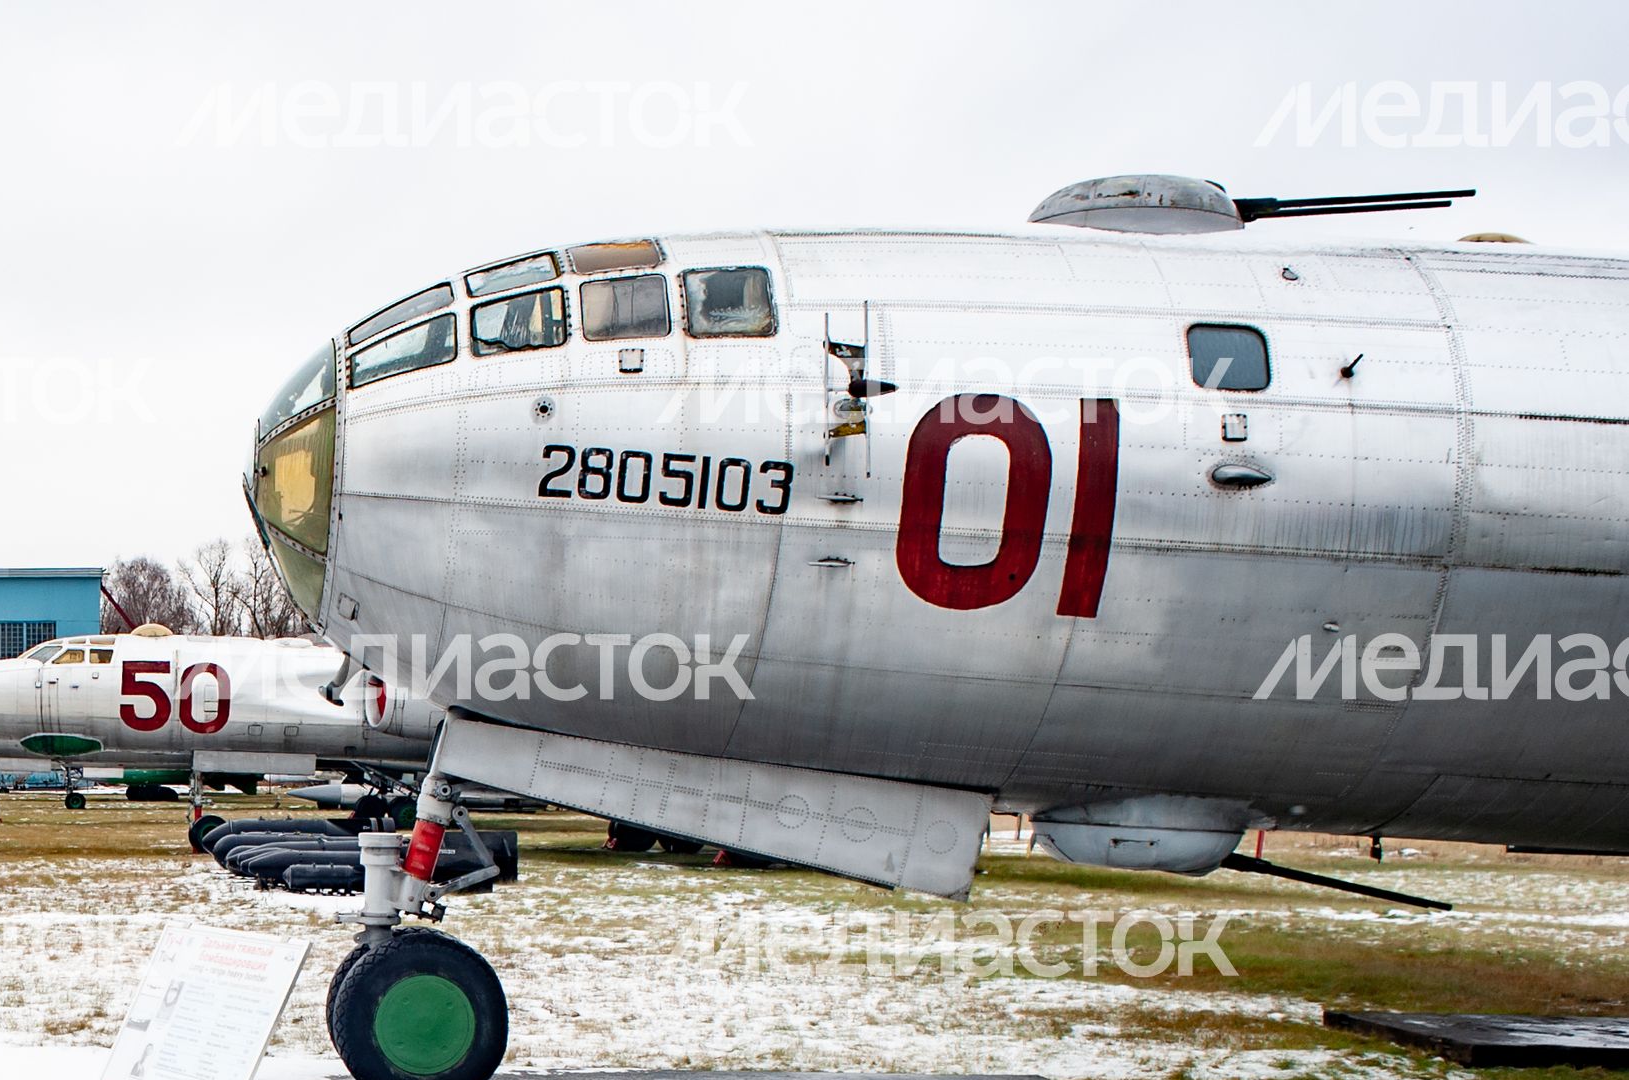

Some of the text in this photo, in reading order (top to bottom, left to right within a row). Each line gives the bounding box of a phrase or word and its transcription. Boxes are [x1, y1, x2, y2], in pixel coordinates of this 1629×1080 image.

[537, 444, 794, 515] 2805103
[896, 392, 1120, 618] 01
[120, 660, 231, 734] 50
